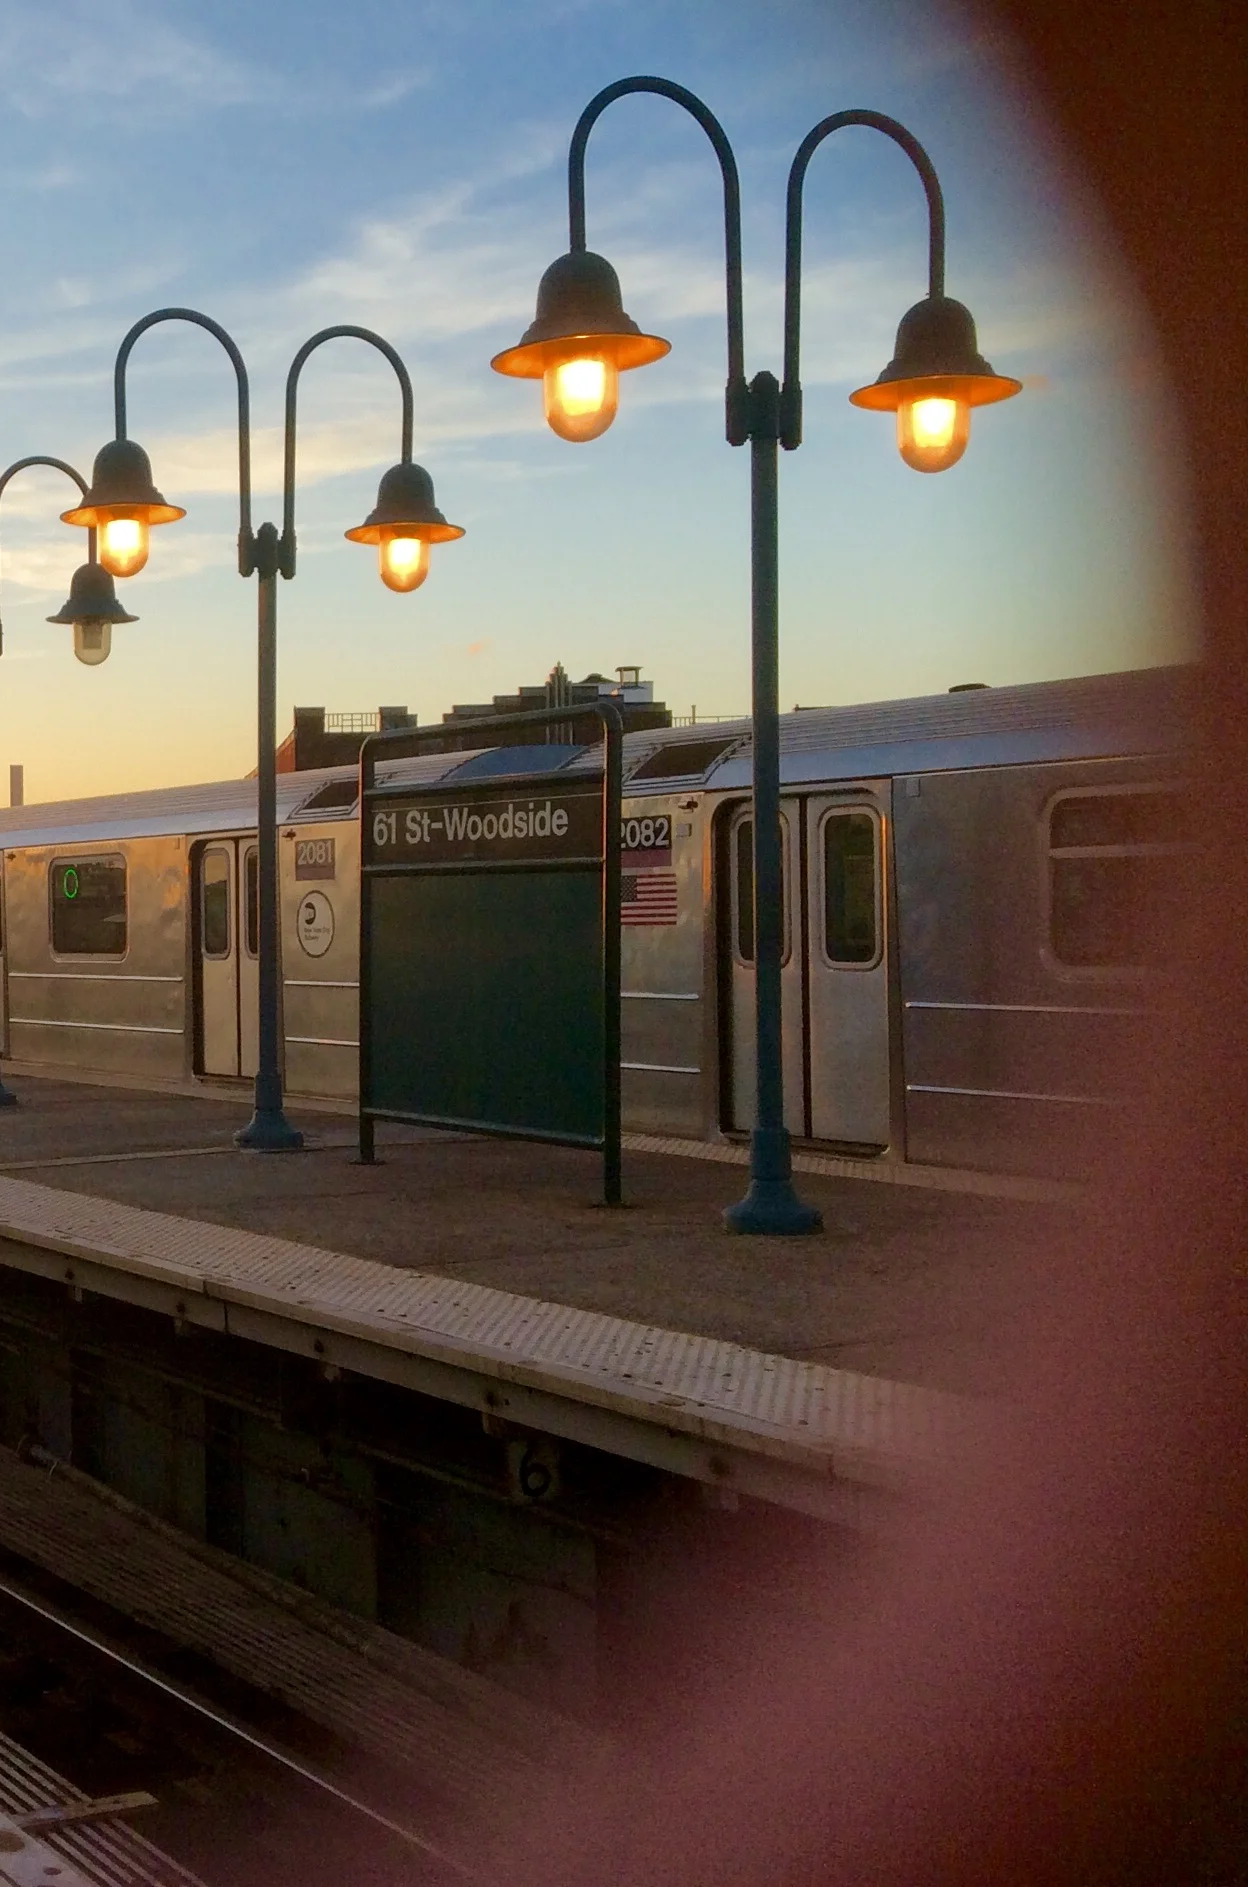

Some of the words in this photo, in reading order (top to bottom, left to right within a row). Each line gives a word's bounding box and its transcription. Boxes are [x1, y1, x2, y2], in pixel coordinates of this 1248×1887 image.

[372, 812, 397, 846] 61
[405, 801, 569, 844] St-Woodside
[297, 840, 333, 866] 2081
[519, 1446, 551, 1497] 6
